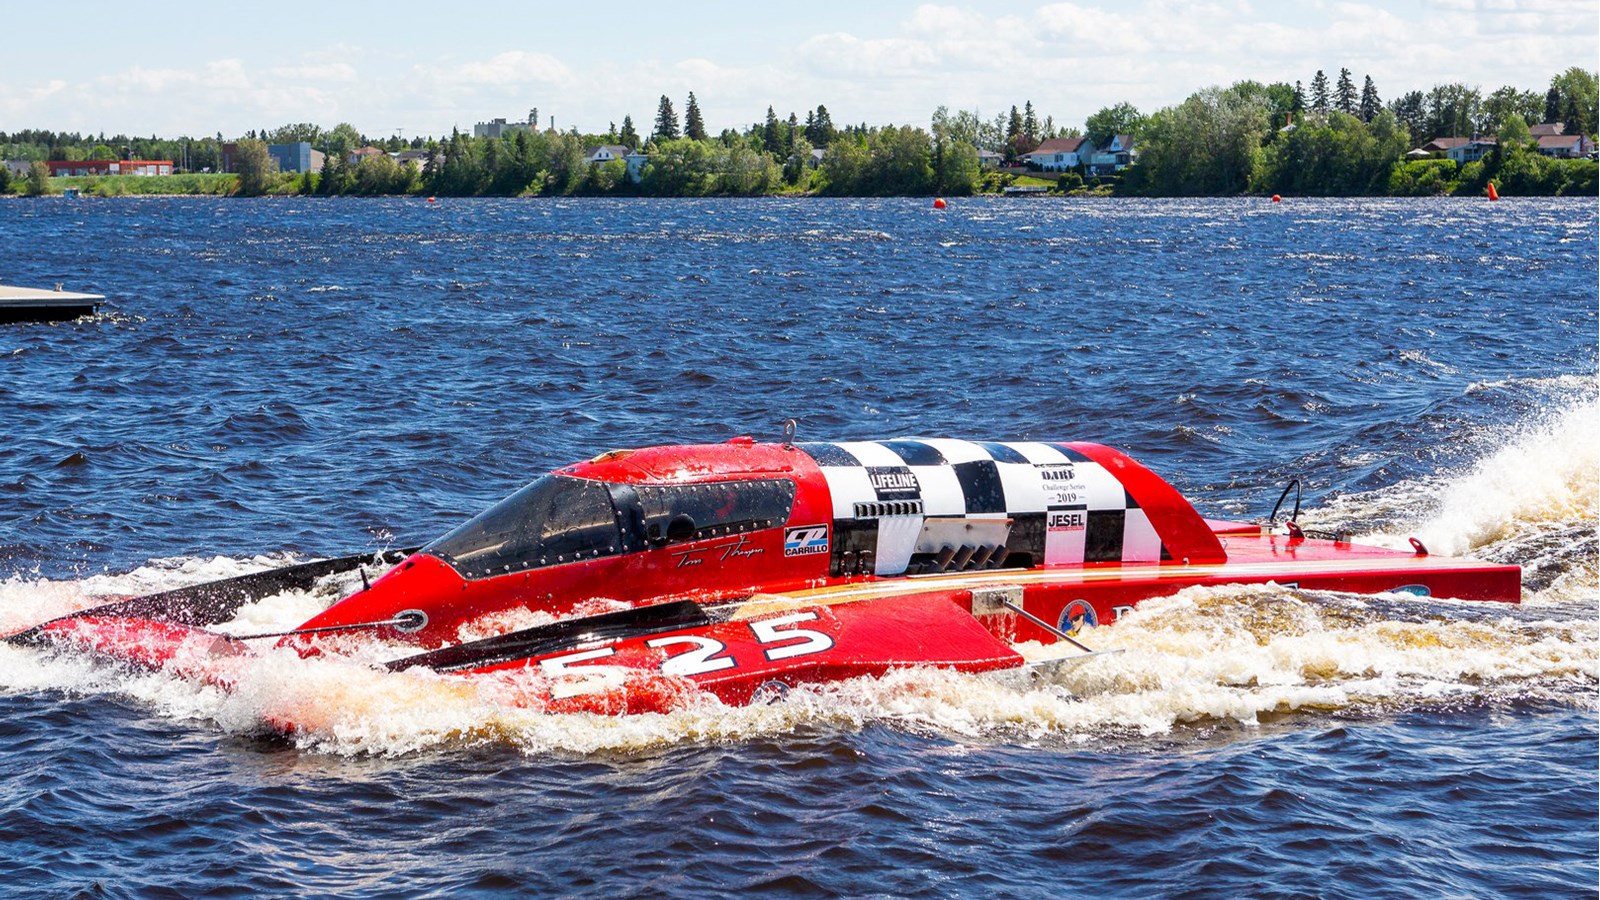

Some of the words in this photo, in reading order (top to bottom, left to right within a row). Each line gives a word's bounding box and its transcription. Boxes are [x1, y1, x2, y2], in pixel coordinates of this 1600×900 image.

[870, 473, 917, 488] LIFELINE
[1042, 483, 1069, 491] Challenge
[1056, 491, 1077, 502] 2019
[1048, 514, 1084, 527] JESEL
[785, 545, 828, 556] CARRILLO
[671, 547, 708, 568] Tom
